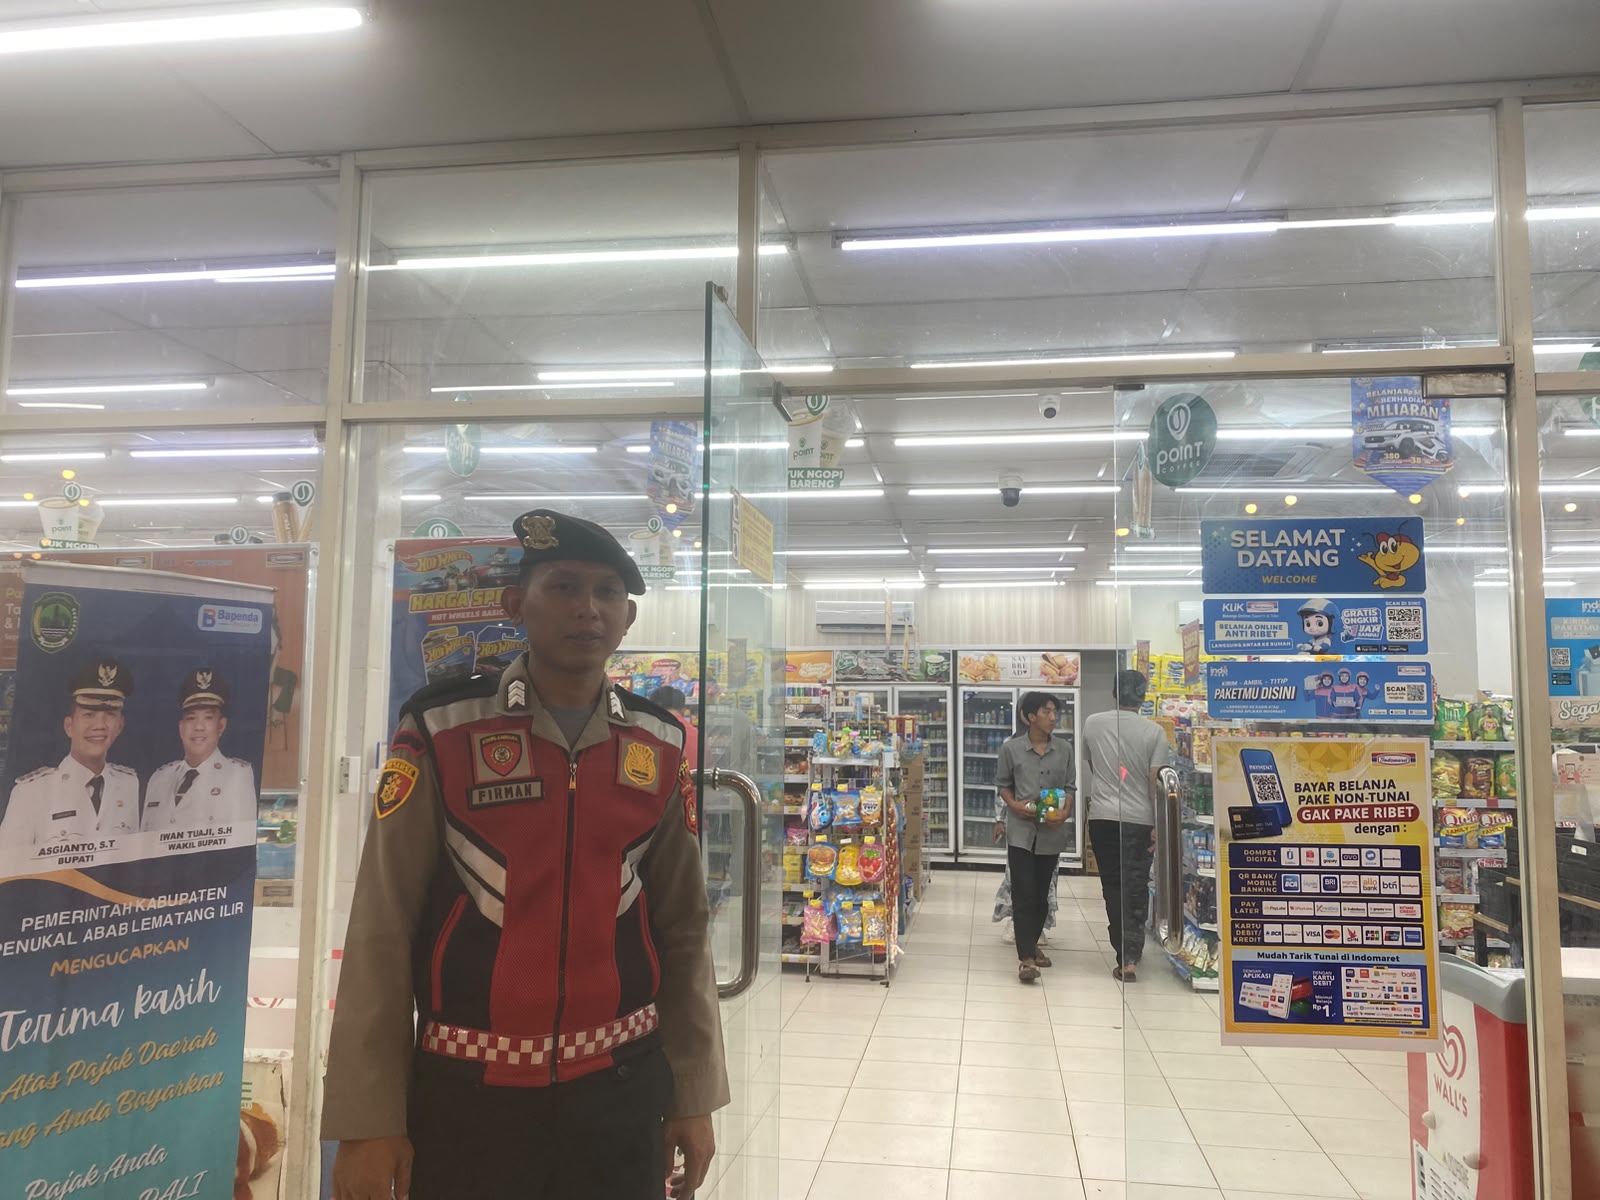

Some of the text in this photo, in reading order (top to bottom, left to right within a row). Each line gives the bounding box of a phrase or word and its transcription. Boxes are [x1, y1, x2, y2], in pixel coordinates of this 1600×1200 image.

[1367, 403, 1439, 420] MILIARAN
[788, 470, 843, 480] UK NGOPI
[790, 479, 835, 488] BARENG
[1230, 528, 1346, 549] SELAMAT
[417, 557, 439, 572] HOT
[1237, 549, 1340, 569] DATANG
[1262, 575, 1318, 584] WELCOME
[411, 591, 469, 612] HARGA
[217, 609, 260, 624] Bapenda
[431, 608, 505, 622] HOT WHEELS BASIC
[1343, 608, 1378, 617] GRATIS
[1343, 617, 1379, 625] ONGKIR
[1358, 624, 1381, 633] JAM
[1225, 630, 1278, 638] ANTI RIBET
[1214, 686, 1296, 700] PAKETMU DISINI
[1560, 699, 1600, 722] Sega
[478, 783, 532, 802] FIRMAN
[1294, 779, 1396, 793] BAYAR BELANJA
[1298, 791, 1410, 805] PAKE NON-TUNAI
[1301, 806, 1414, 821] GAK PAKE RIBET
[160, 831, 185, 842] IWAN
[217, 826, 233, 837] S.H
[1354, 822, 1400, 836] dengan
[1446, 825, 1469, 834] FAMILY
[1482, 825, 1505, 835] FAMILY
[38, 838, 116, 857] ASGIANTO, S.T
[168, 838, 227, 851] WAKIL BUPATI
[57, 853, 94, 866] BUPATI
[1362, 878, 1378, 887] allo
[21, 885, 228, 932] PEMERINTAH KABUPATEN
[83, 922, 129, 944] ABAB
[131, 907, 216, 933] LEMATANG
[219, 901, 244, 919] ILIR
[50, 937, 190, 977] MENGUCAPKAN
[1257, 952, 1288, 960] Mudah
[1289, 952, 1312, 960] Tarik
[1313, 952, 1339, 961] Tunai
[1351, 954, 1400, 962] Indomaret
[0, 967, 222, 1052] Terima kasih
[0, 1027, 220, 1101] Atas Pajak Daerah
[1434, 1072, 1468, 1118] WALL'S
[0, 1070, 225, 1150] ang Anda Bayarkan
[25, 1143, 169, 1200] Pajak Anda
